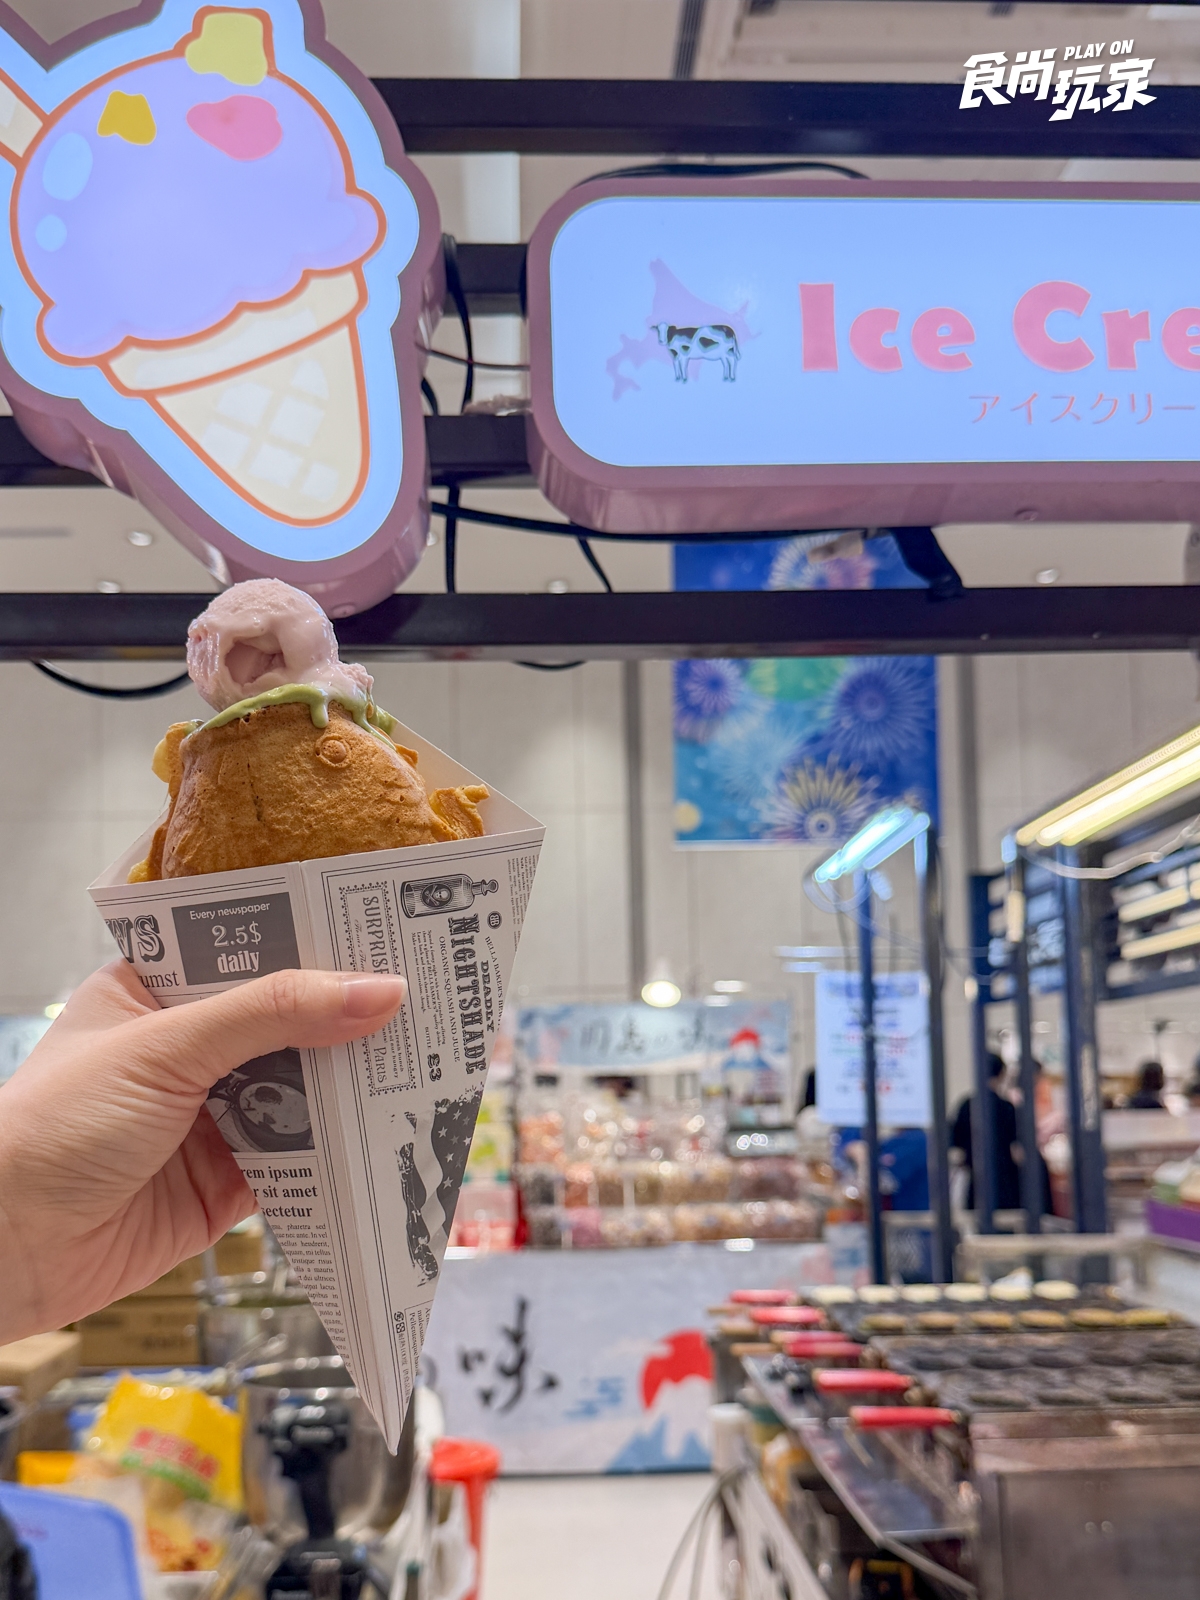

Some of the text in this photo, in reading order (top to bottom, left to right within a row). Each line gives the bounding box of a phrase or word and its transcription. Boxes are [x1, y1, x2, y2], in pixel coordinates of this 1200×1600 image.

[800, 282, 976, 373] Ice
[189, 903, 270, 920] Every newspaper
[211, 921, 262, 948] 2.5$
[217, 950, 259, 973] daily
[438, 935, 460, 1062] ORGANIC SQUASH AND JUICE
[447, 913, 487, 1074] NIGHTSHADE
[480, 960, 494, 1032] DEADLY
[374, 1047, 387, 1083] PARIS
[426, 1052, 443, 1082] £3
[268, 1166, 313, 1182] ipsum
[262, 1186, 278, 1198] sit
[283, 1185, 318, 1198] amet
